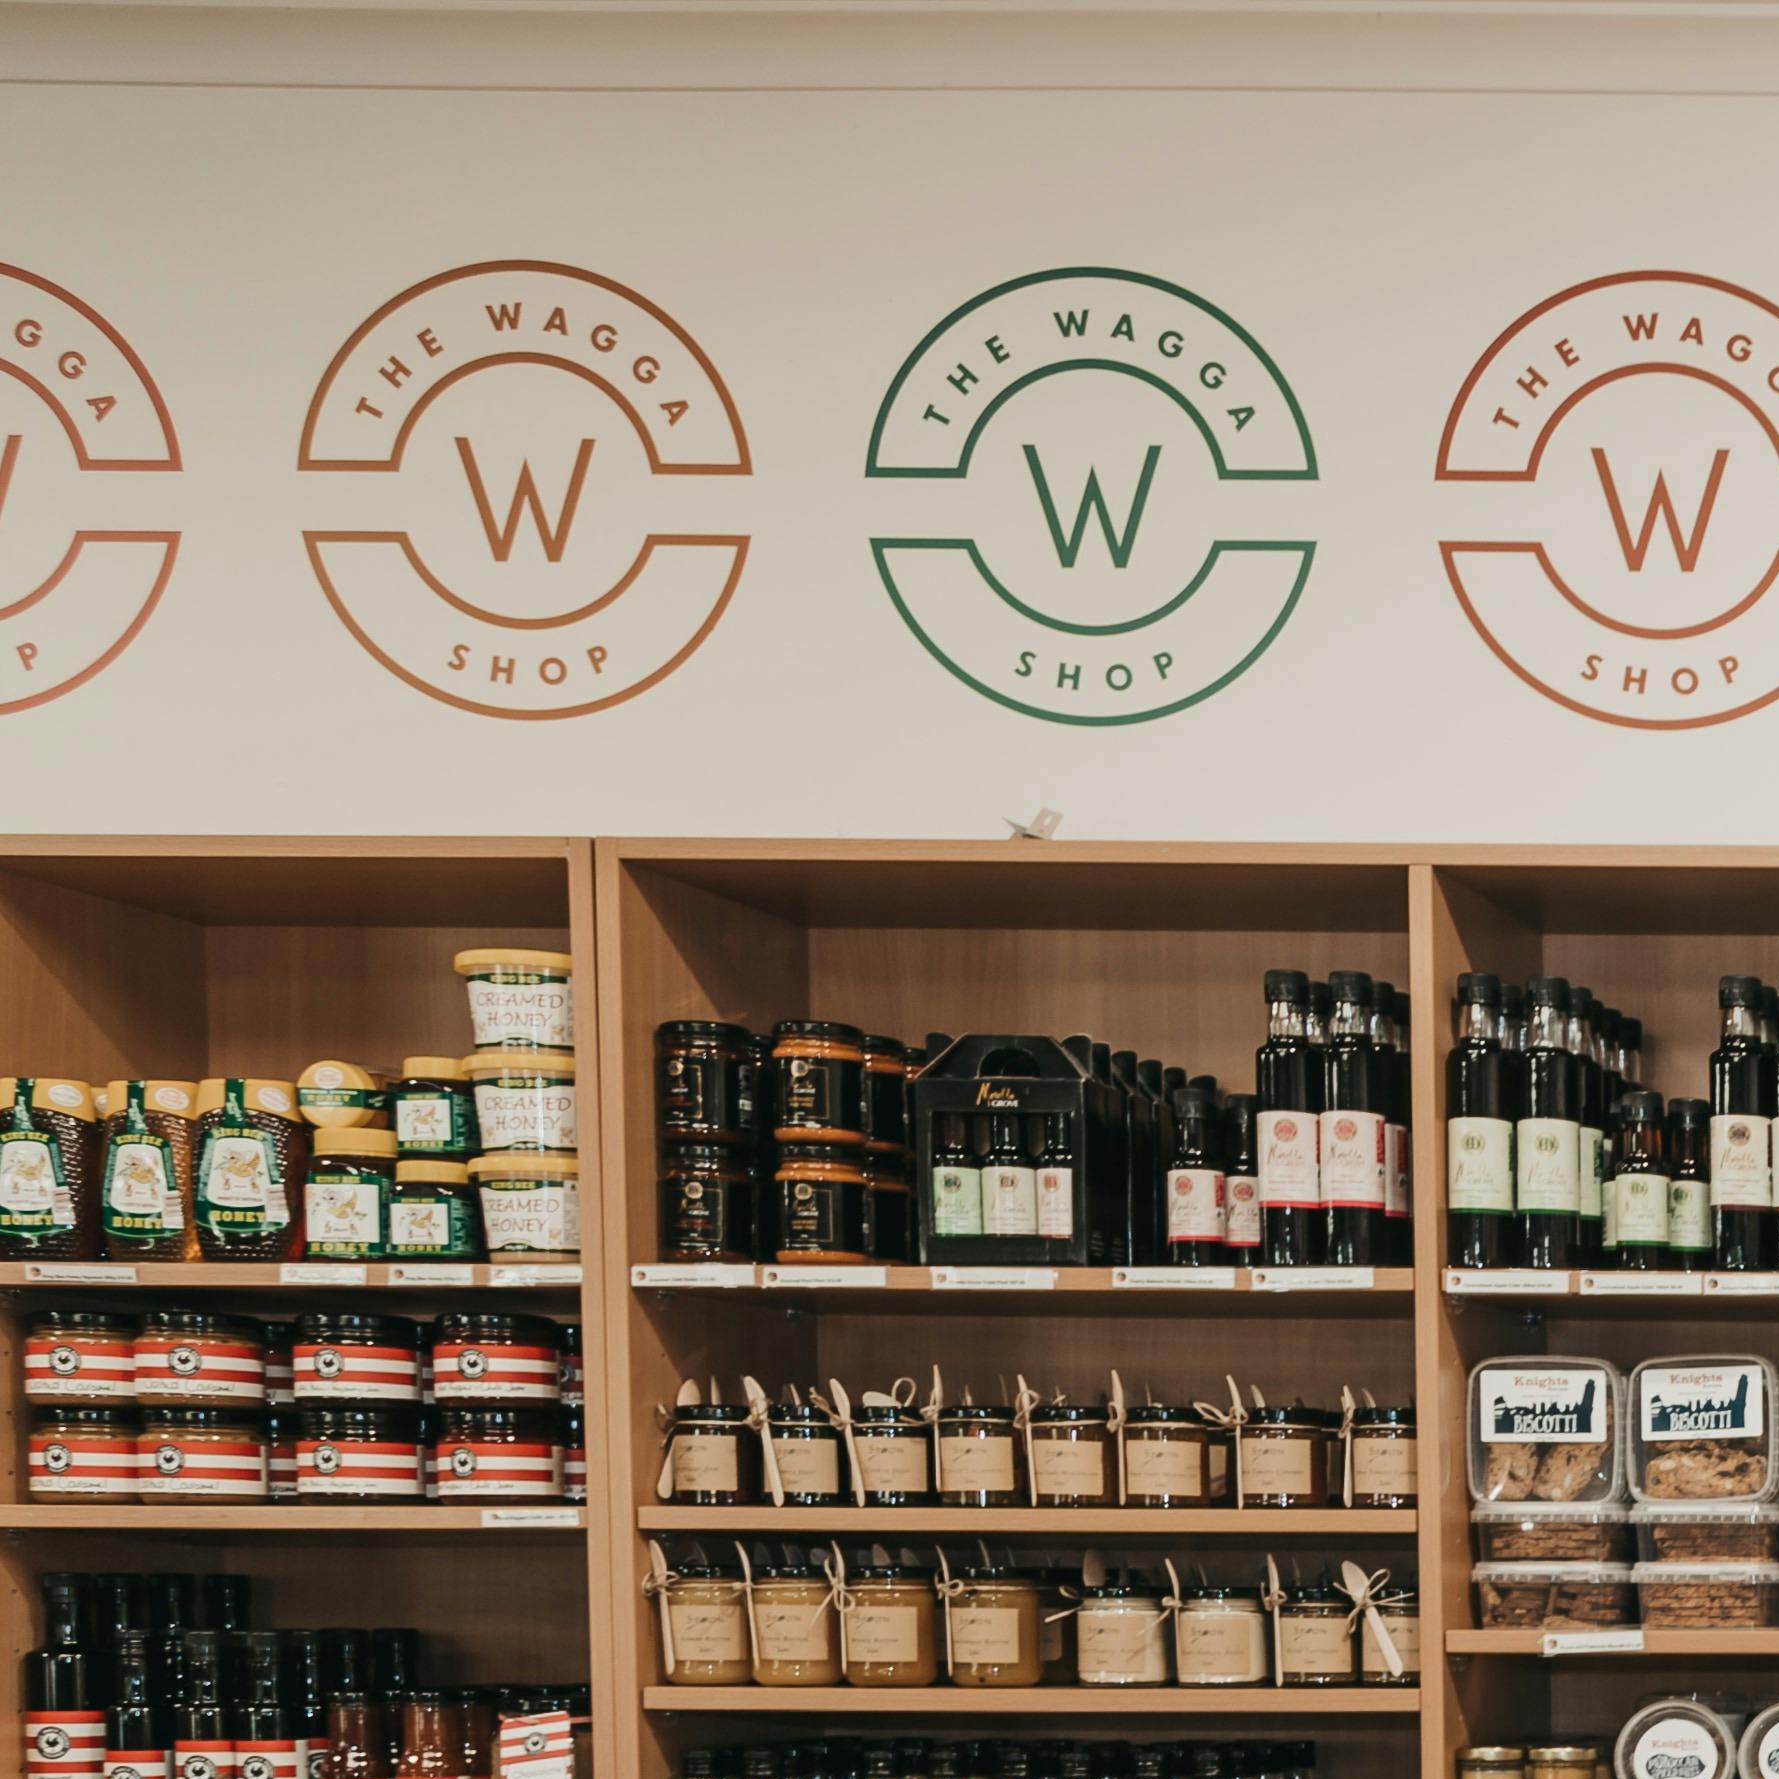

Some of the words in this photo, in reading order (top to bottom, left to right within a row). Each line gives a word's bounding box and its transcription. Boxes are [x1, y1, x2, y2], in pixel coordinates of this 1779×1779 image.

[14, 319, 117, 422] GGA
[355, 328, 443, 418] THE
[485, 302, 689, 426] WAGGA
[923, 335, 1010, 425] THE
[1053, 309, 1255, 432] WAGGA
[1492, 338, 1580, 429] THE
[454, 437, 596, 562] W
[1022, 444, 1162, 568] W
[1590, 448, 1730, 572] W
[448, 644, 608, 685] SHOP
[1013, 651, 1174, 691] SHOP
[1580, 655, 1739, 699] SHOP
[477, 991, 564, 1010] CREAMED
[487, 1011, 553, 1028] HONEY
[484, 1096, 572, 1112] CREAMED
[495, 1115, 562, 1131] HONEY
[1, 1214, 52, 1226] HONEY
[112, 1215, 163, 1229] HONEY
[212, 1210, 266, 1223] HONEY
[1513, 1376, 1569, 1388] Knights
[1669, 1372, 1723, 1386] Knights
[1513, 1414, 1578, 1434] BISCOTTI
[1669, 1410, 1732, 1432] BISCOTTI
